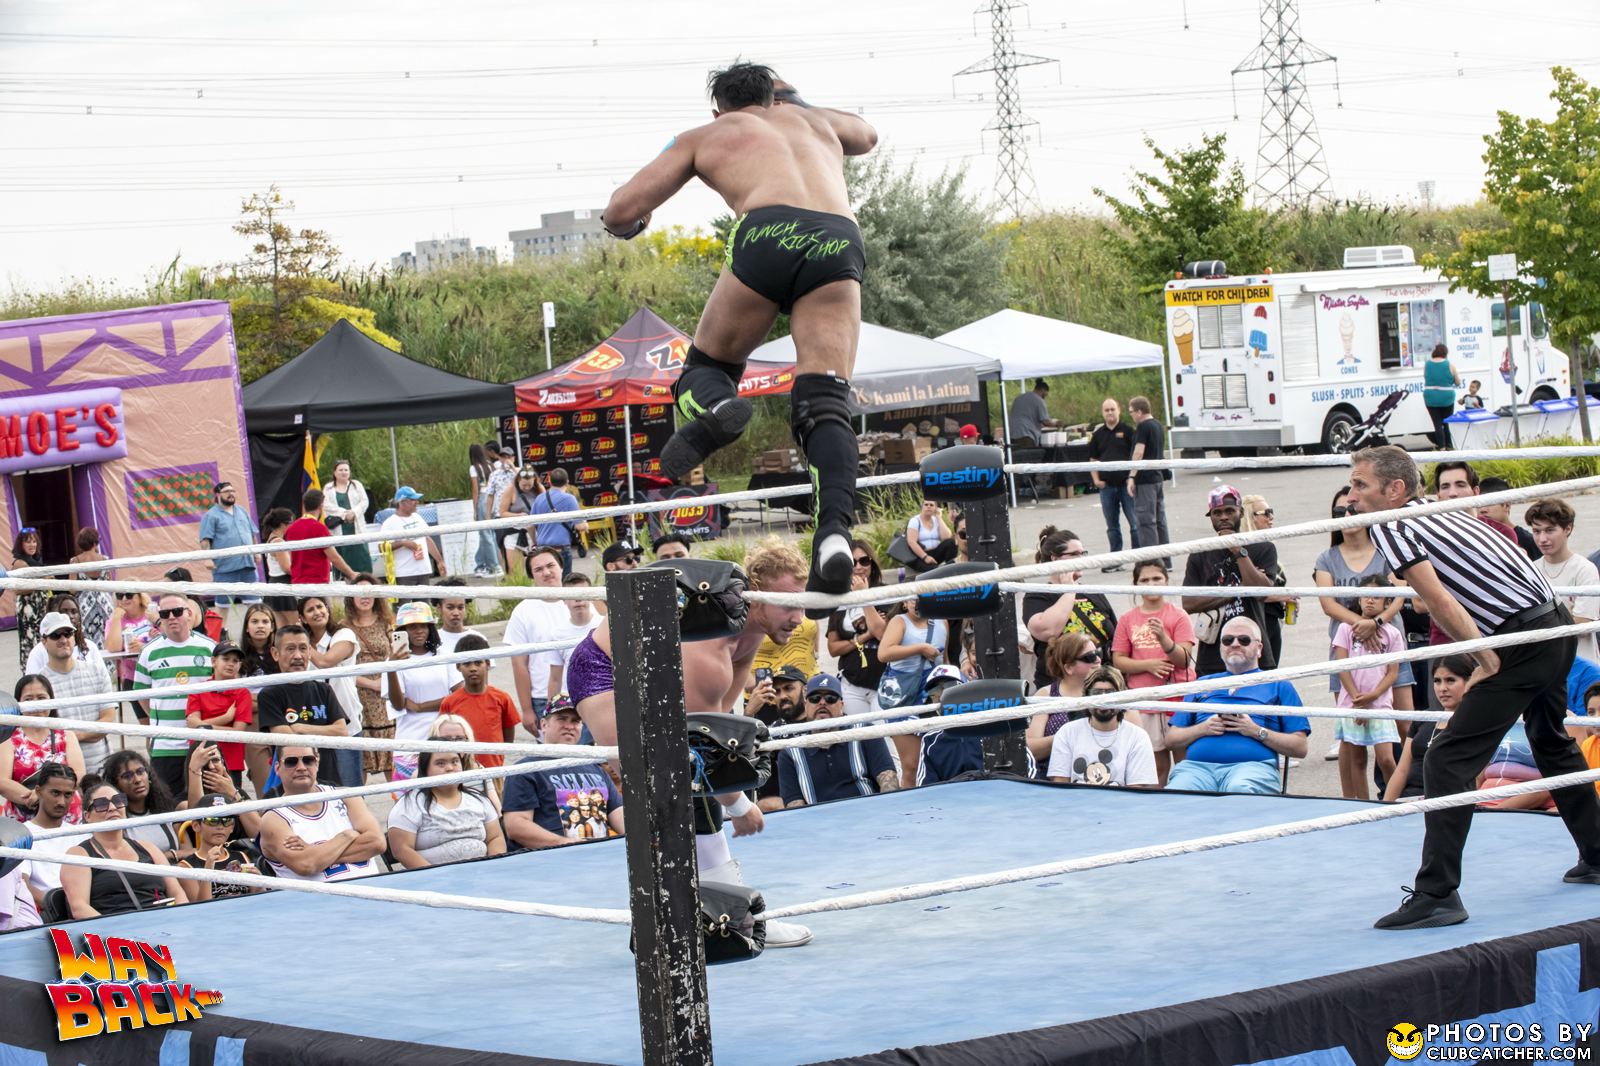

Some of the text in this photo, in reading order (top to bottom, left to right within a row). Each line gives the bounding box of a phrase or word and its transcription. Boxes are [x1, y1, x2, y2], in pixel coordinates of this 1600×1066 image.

[742, 219, 800, 249] PUNCH
[806, 240, 850, 260] CHOP
[1172, 287, 1270, 302] WATCH FOR CHILDREN
[1451, 326, 1483, 336] ICE CREAM
[1340, 366, 1358, 375] CONES
[738, 376, 770, 392] HITS
[873, 386, 911, 406] Kami
[912, 385, 926, 400] la
[927, 382, 971, 399] Latina
[1311, 382, 1424, 402] SLUSH SPLITS SHAKES CONE
[0, 403, 118, 459] MOE'S
[924, 466, 1001, 488] Destiny
[693, 526, 710, 534] HITS
